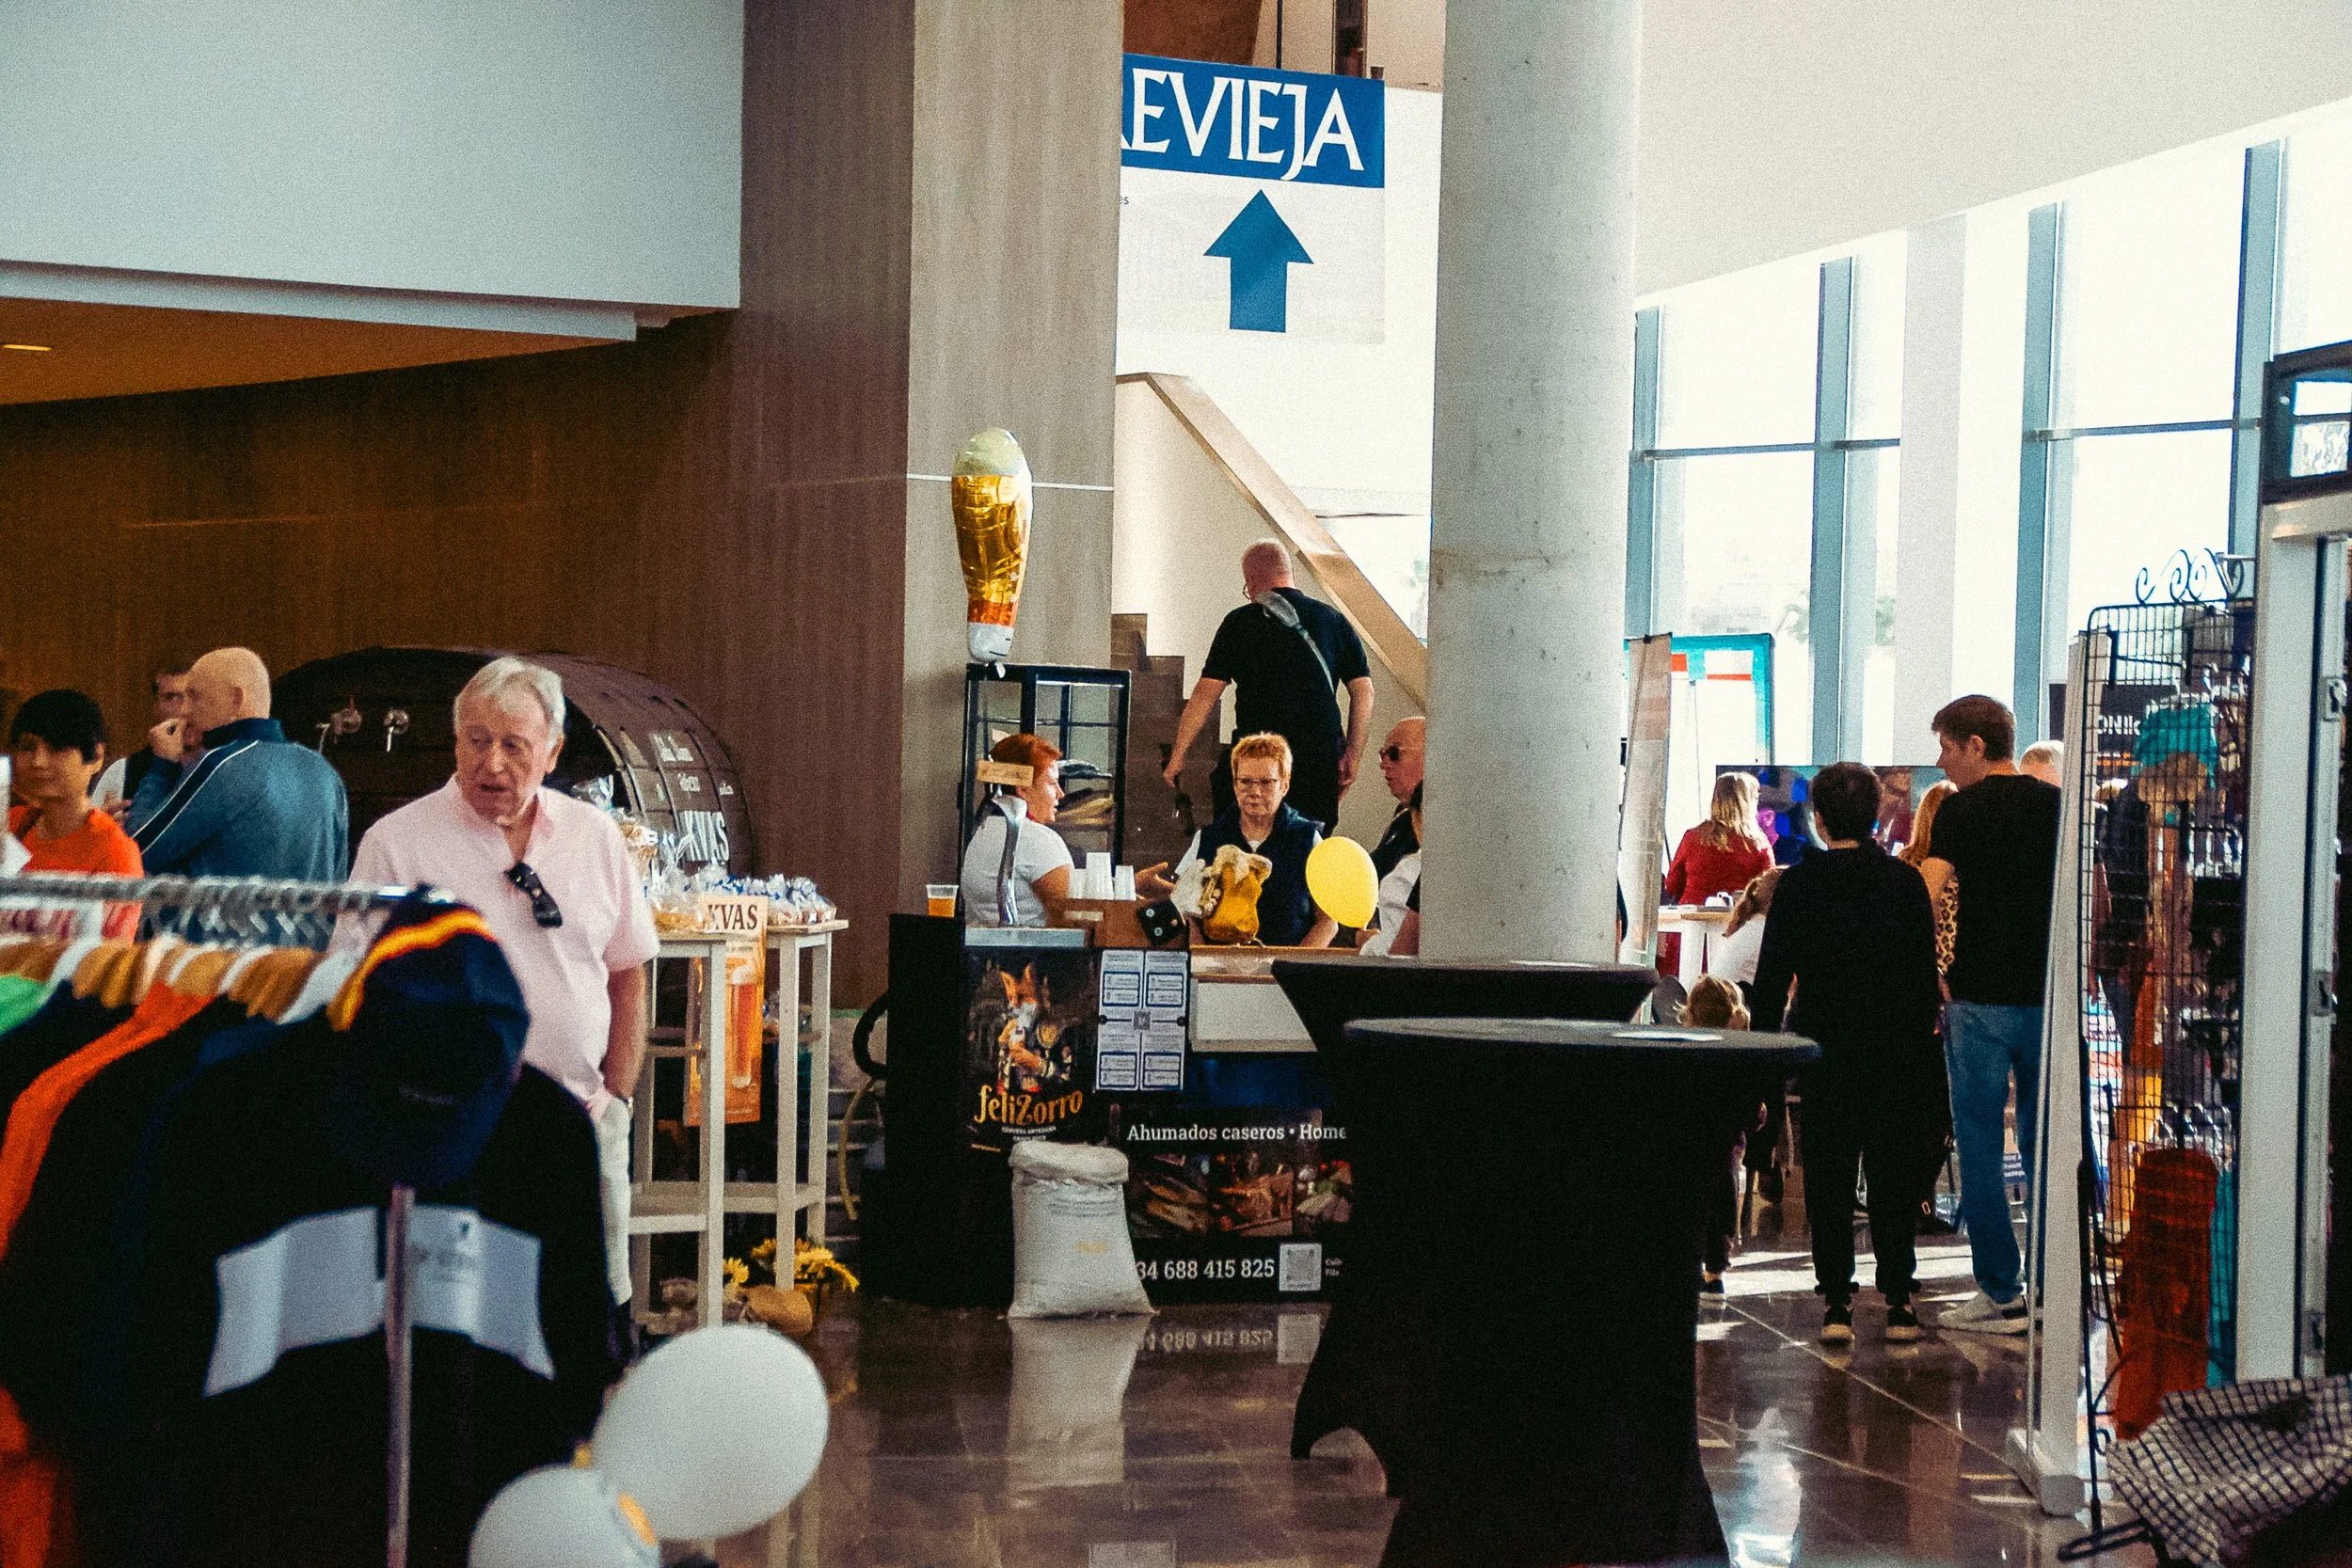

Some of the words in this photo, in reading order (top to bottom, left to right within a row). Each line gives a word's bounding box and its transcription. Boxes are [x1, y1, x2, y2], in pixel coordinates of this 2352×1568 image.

[1121, 68, 1364, 181] EVIEJA
[1126, 1124, 1217, 1141] Ahumados
[1221, 1126, 1285, 1140] caseros
[1164, 1259, 1199, 1280] 688
[1203, 1259, 1235, 1279] 415
[1241, 1259, 1275, 1278] 825
